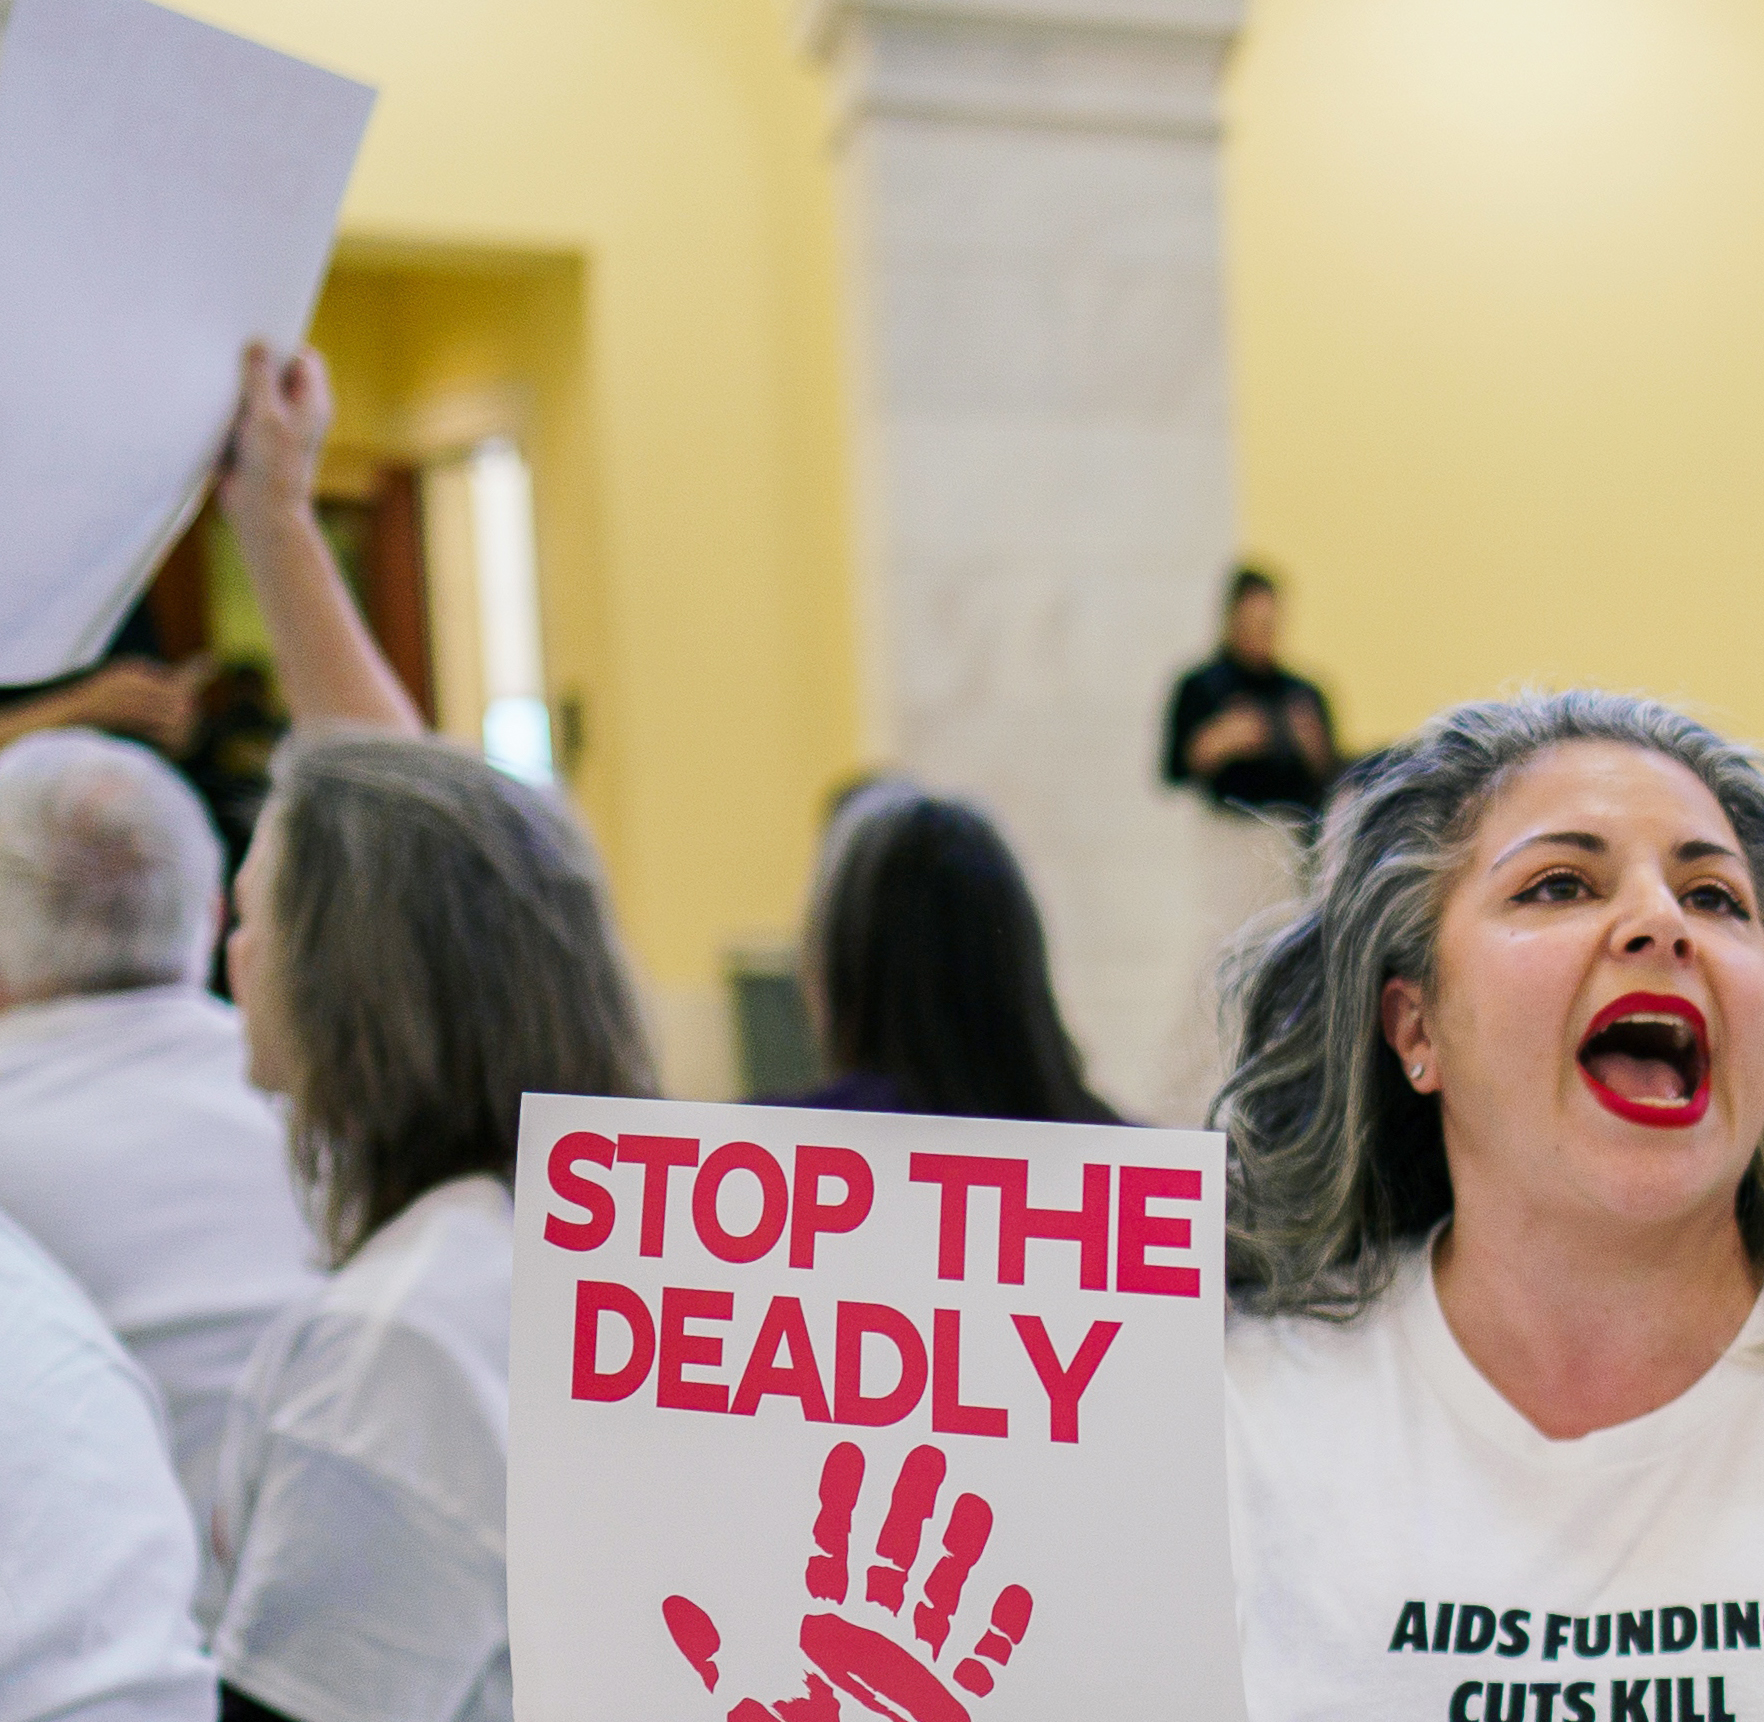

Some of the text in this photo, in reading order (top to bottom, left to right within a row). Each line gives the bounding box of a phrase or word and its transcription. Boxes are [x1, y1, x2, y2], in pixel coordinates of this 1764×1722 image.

[544, 1132, 1203, 1298] STOP THE
[570, 1279, 1124, 1444] DEADLY
[1388, 1601, 1531, 1658] AIDS
